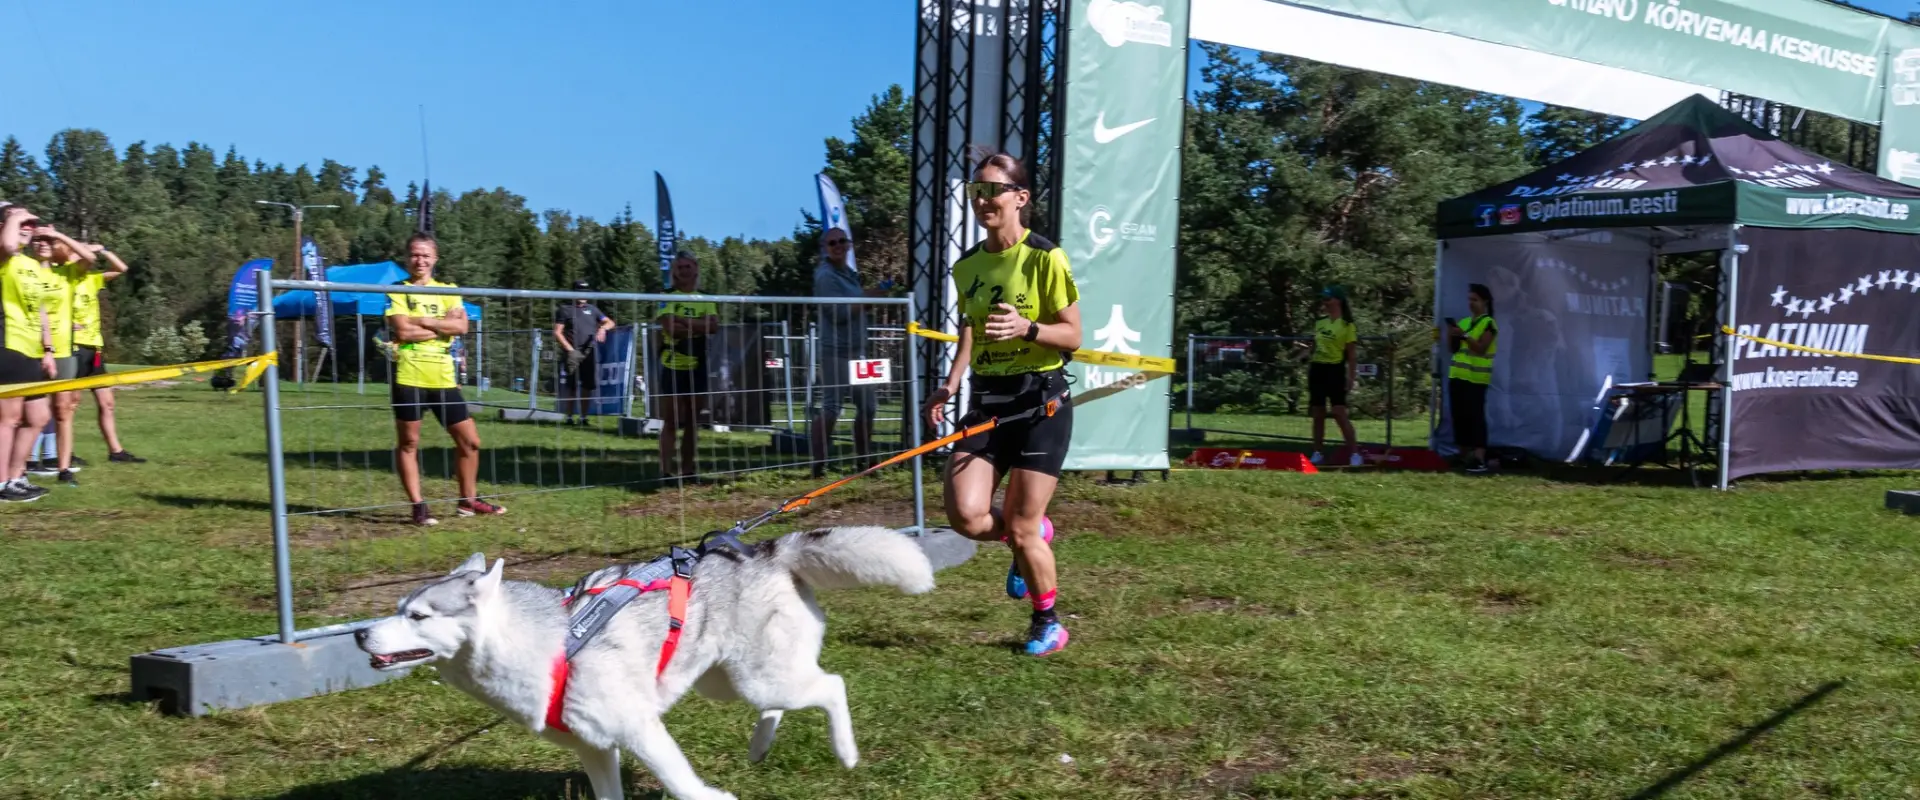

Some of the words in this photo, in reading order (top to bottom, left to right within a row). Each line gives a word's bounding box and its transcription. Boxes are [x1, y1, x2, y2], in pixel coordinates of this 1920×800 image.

[1644, 0, 1767, 52] KÕRVEMAA
[1769, 33, 1878, 77] KESKUSSE
[1527, 191, 1678, 221] @platinum.eesti
[990, 285, 1004, 304] 2
[1734, 323, 1869, 360] PLATINUM
